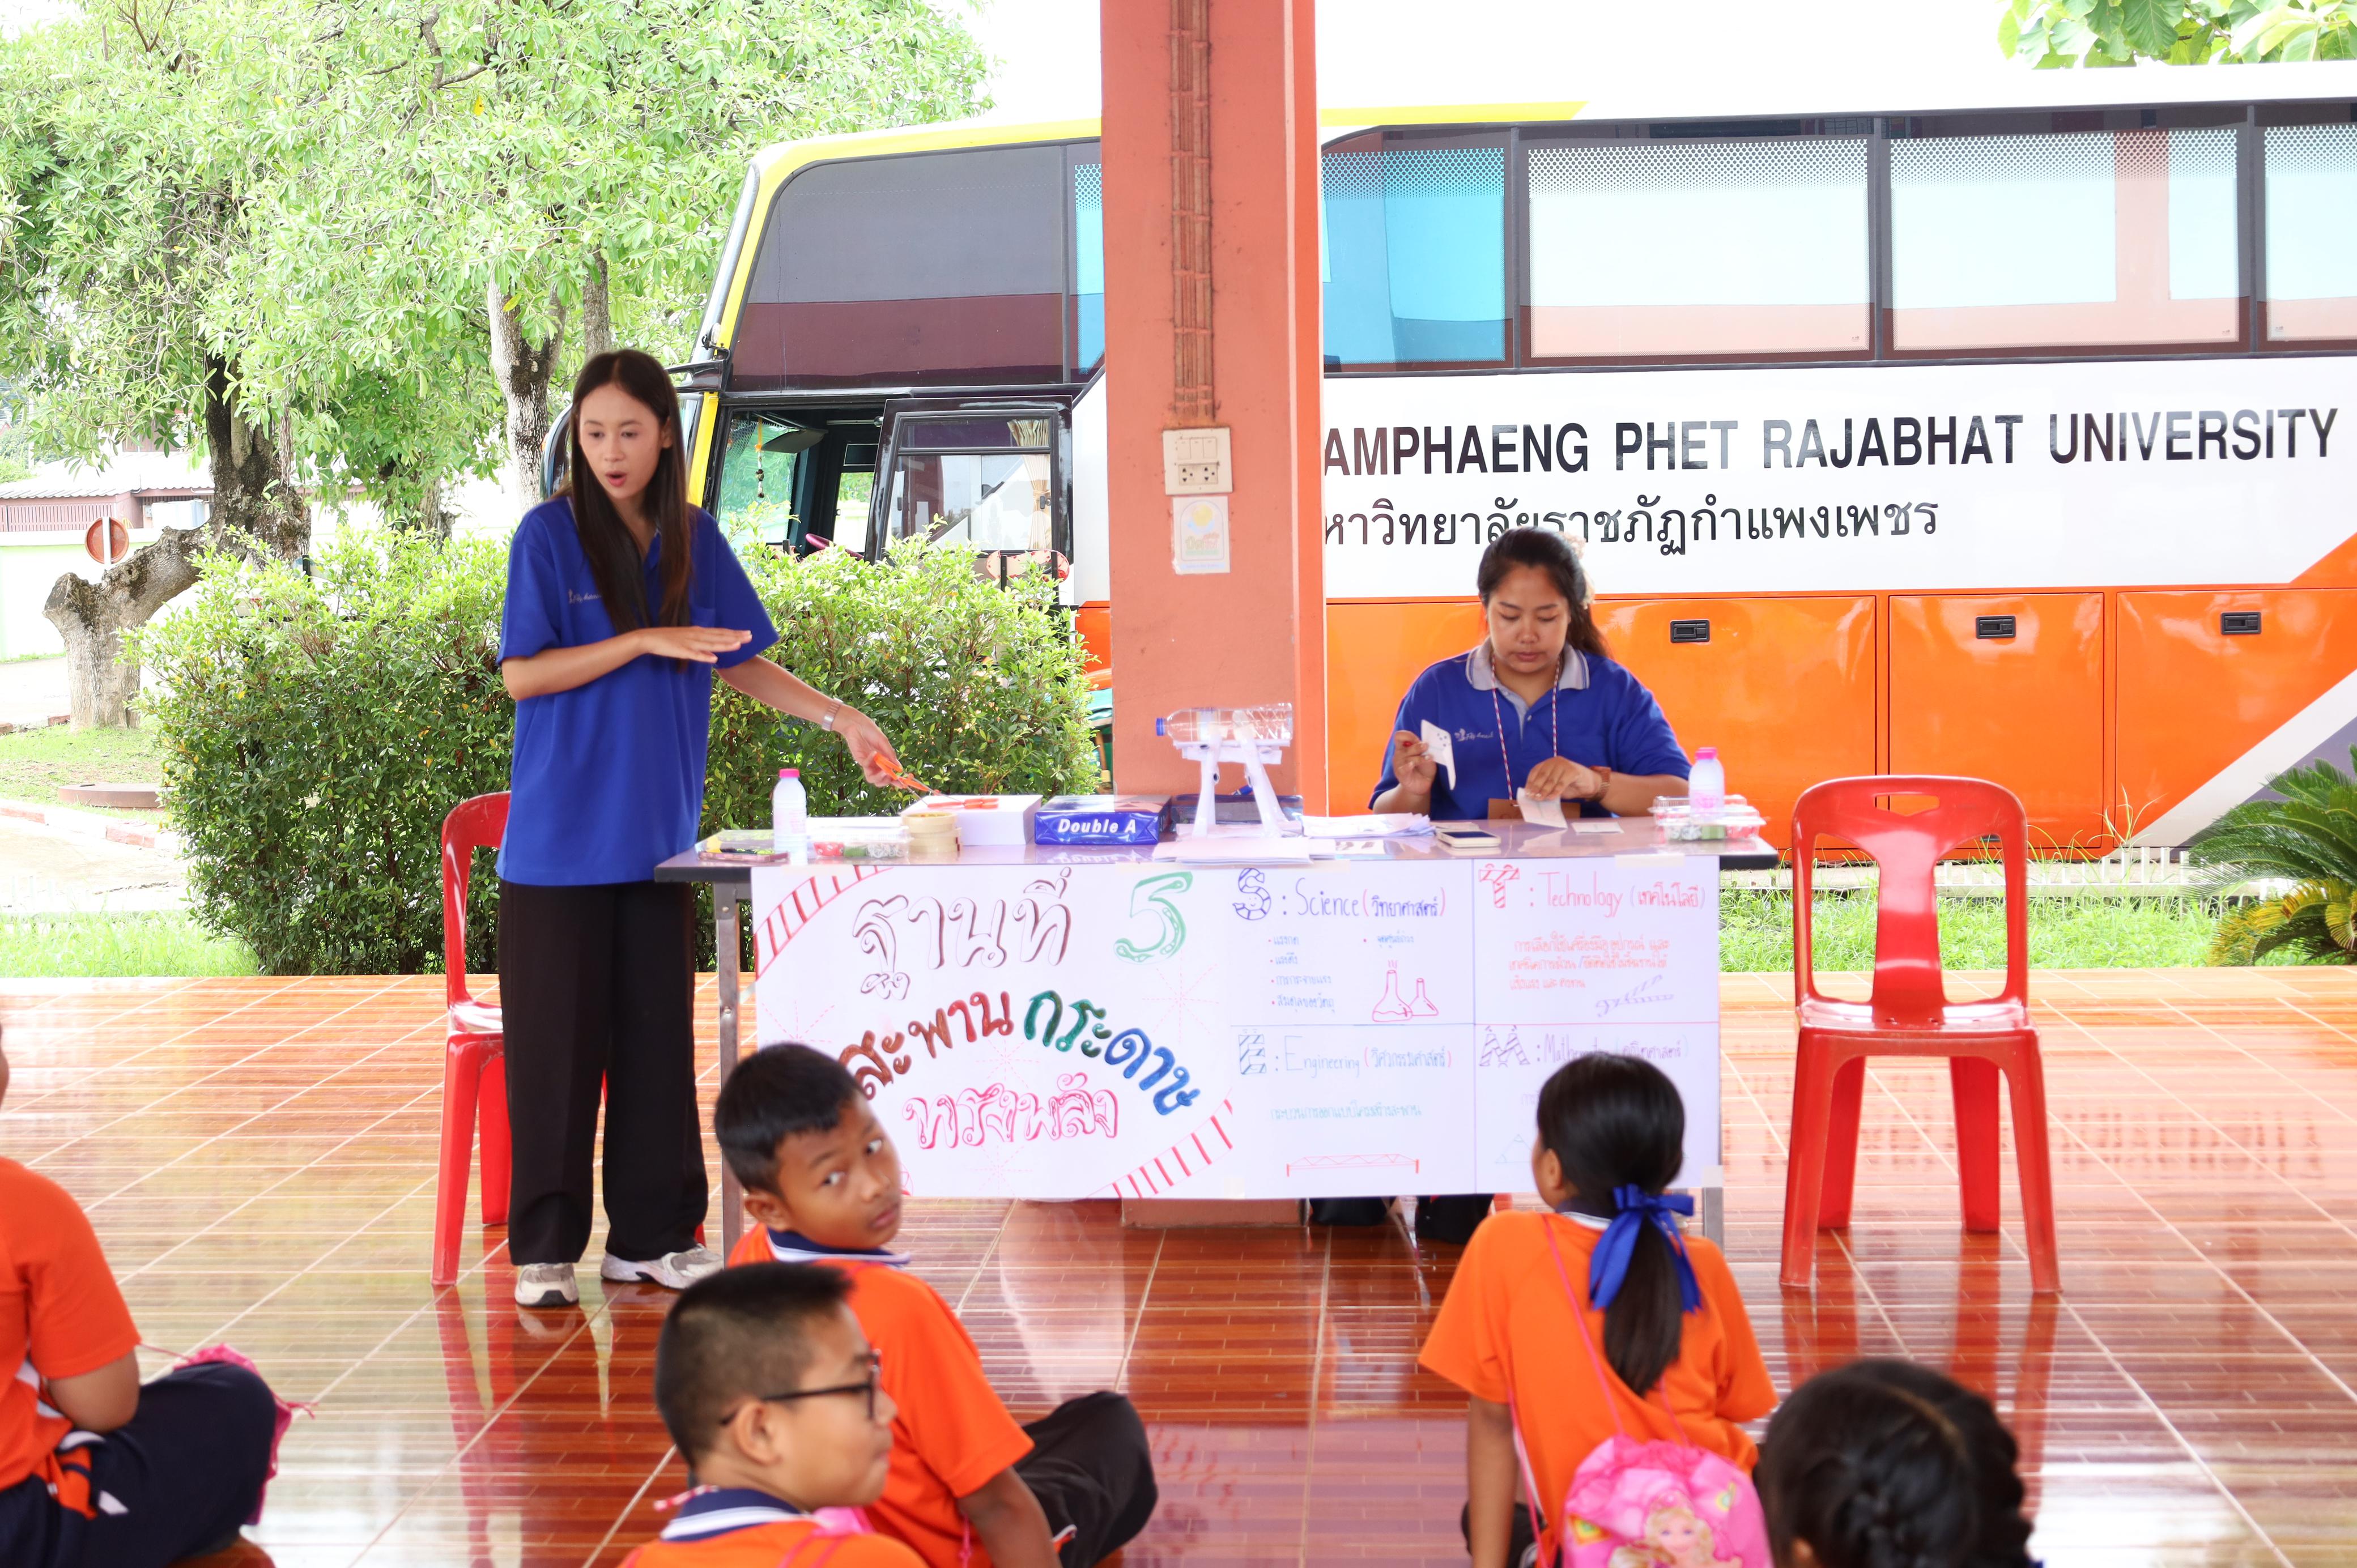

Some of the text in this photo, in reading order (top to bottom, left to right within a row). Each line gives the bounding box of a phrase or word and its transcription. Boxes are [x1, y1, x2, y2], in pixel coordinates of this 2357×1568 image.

[1325, 408, 2338, 476] AMPHAENG PHET RAJABHAT UNIVERSITY
[1325, 493, 1939, 555] หาวิทยาลัยราชภัฏกำแพงเพชร
[1057, 819, 1137, 834] Double A
[1232, 867, 1271, 921] S
[1296, 877, 1359, 917] Science
[1479, 864, 1520, 909] T
[1537, 871, 1624, 918] Technology
[852, 866, 1193, 1000] ฐานที่ 5
[1239, 1034, 1267, 1075] E
[1284, 1035, 1360, 1078] Engineering
[1479, 1033, 1531, 1066] M
